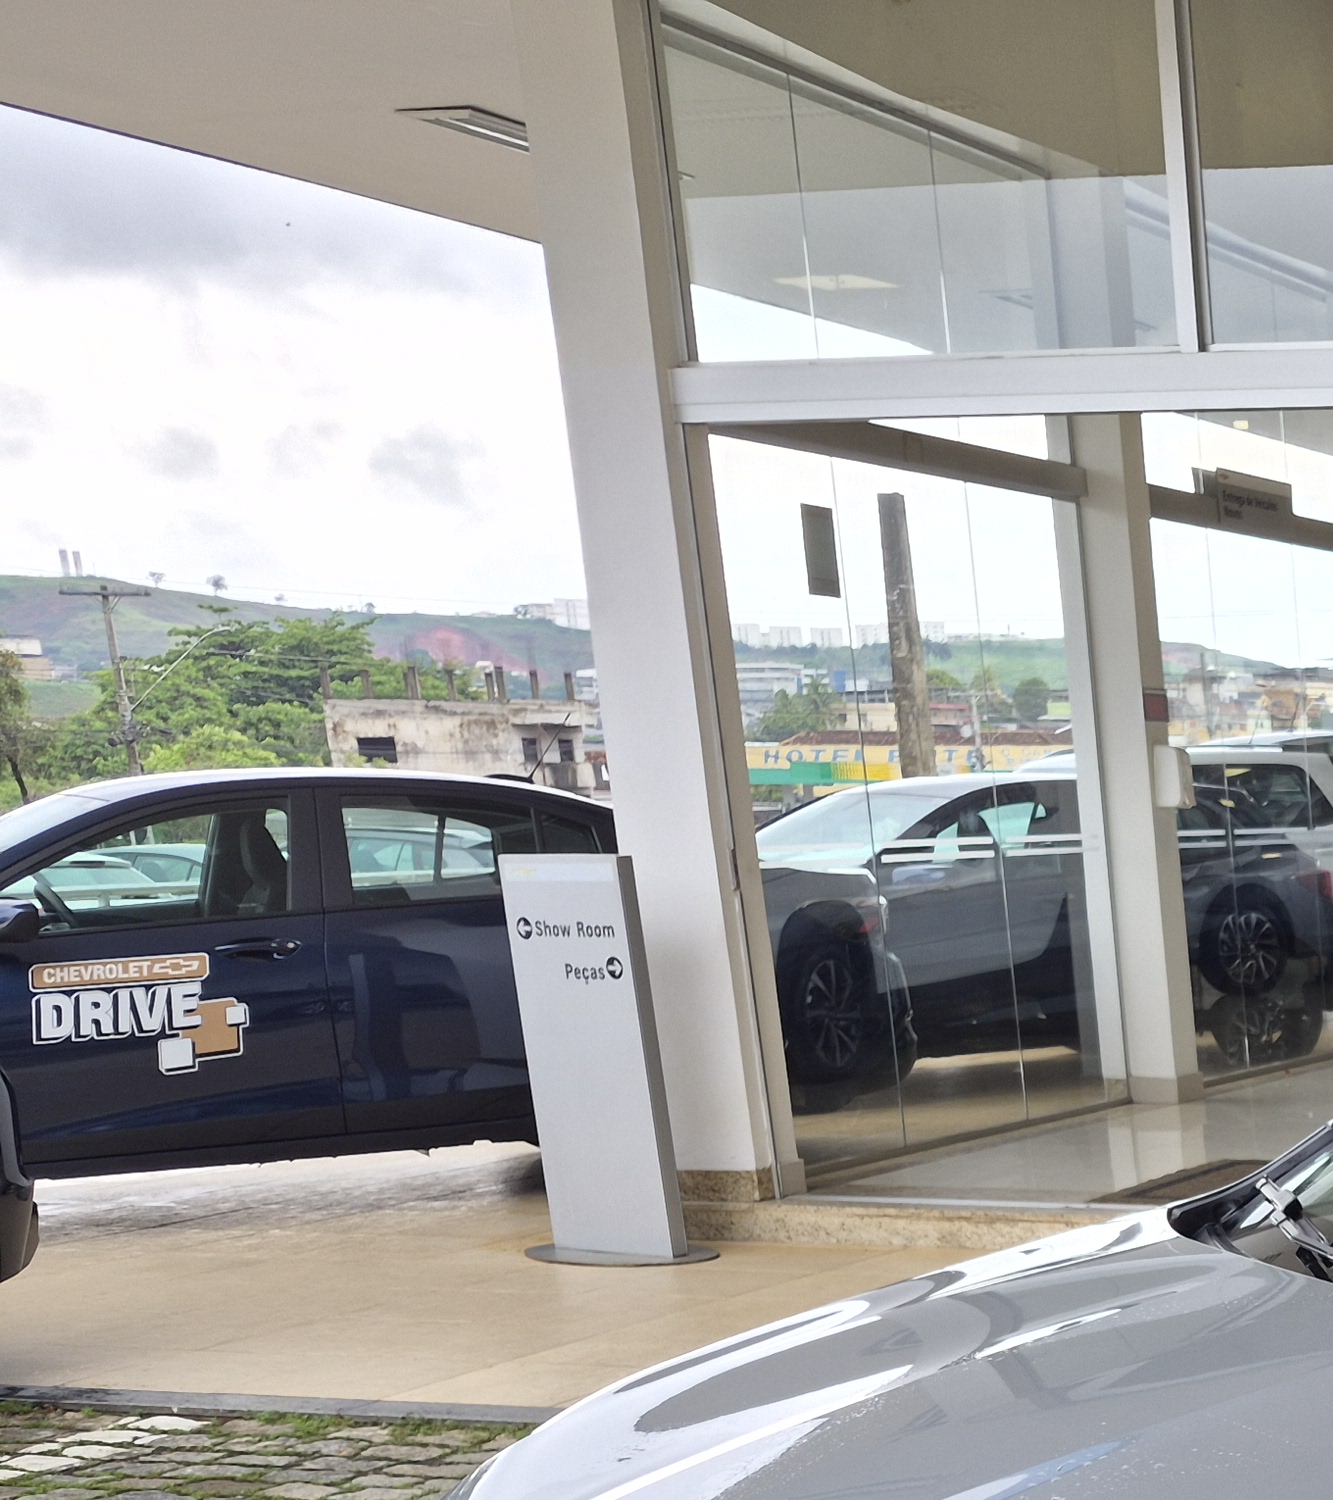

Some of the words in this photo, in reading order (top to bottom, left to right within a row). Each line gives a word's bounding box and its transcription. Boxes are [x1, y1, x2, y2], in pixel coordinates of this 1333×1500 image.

[534, 920, 571, 938] Show
[576, 921, 616, 938] Room
[42, 961, 152, 984] CHEVROLET
[564, 963, 606, 985] Peças
[36, 981, 202, 1043] DRIVE
